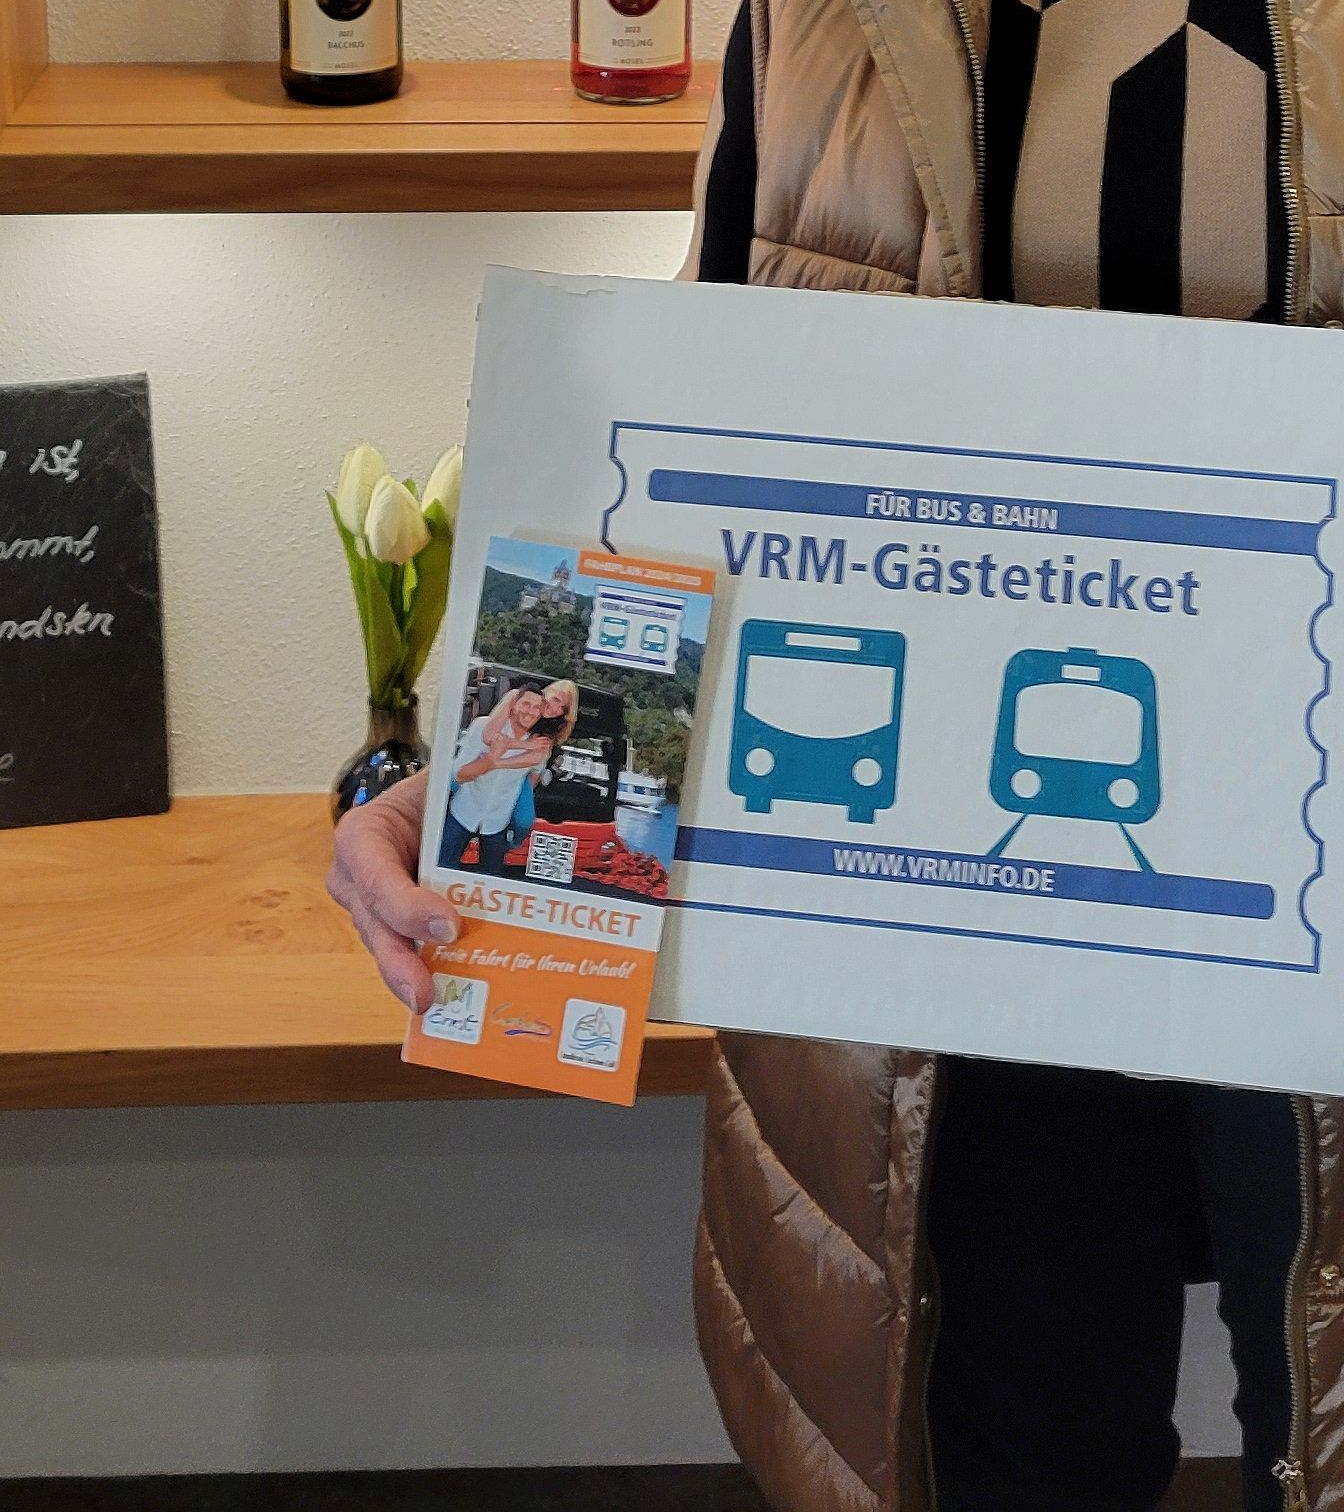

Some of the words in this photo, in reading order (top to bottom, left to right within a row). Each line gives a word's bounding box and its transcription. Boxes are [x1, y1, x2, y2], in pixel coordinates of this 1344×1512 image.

[327, 39, 366, 49] BACCHUS
[864, 493, 911, 517] FÜR
[916, 498, 961, 522] BUS
[967, 502, 987, 525] &
[991, 505, 1060, 530] BAHN
[720, 527, 1201, 617] VRM-Gästeticket
[832, 848, 1056, 893] WWW.VRMINFO.DE
[446, 880, 642, 937] GÄSTE-TICKET
[468, 948, 511, 968] Fahrt
[510, 951, 536, 972] für
[578, 958, 635, 979] Urlaub!
